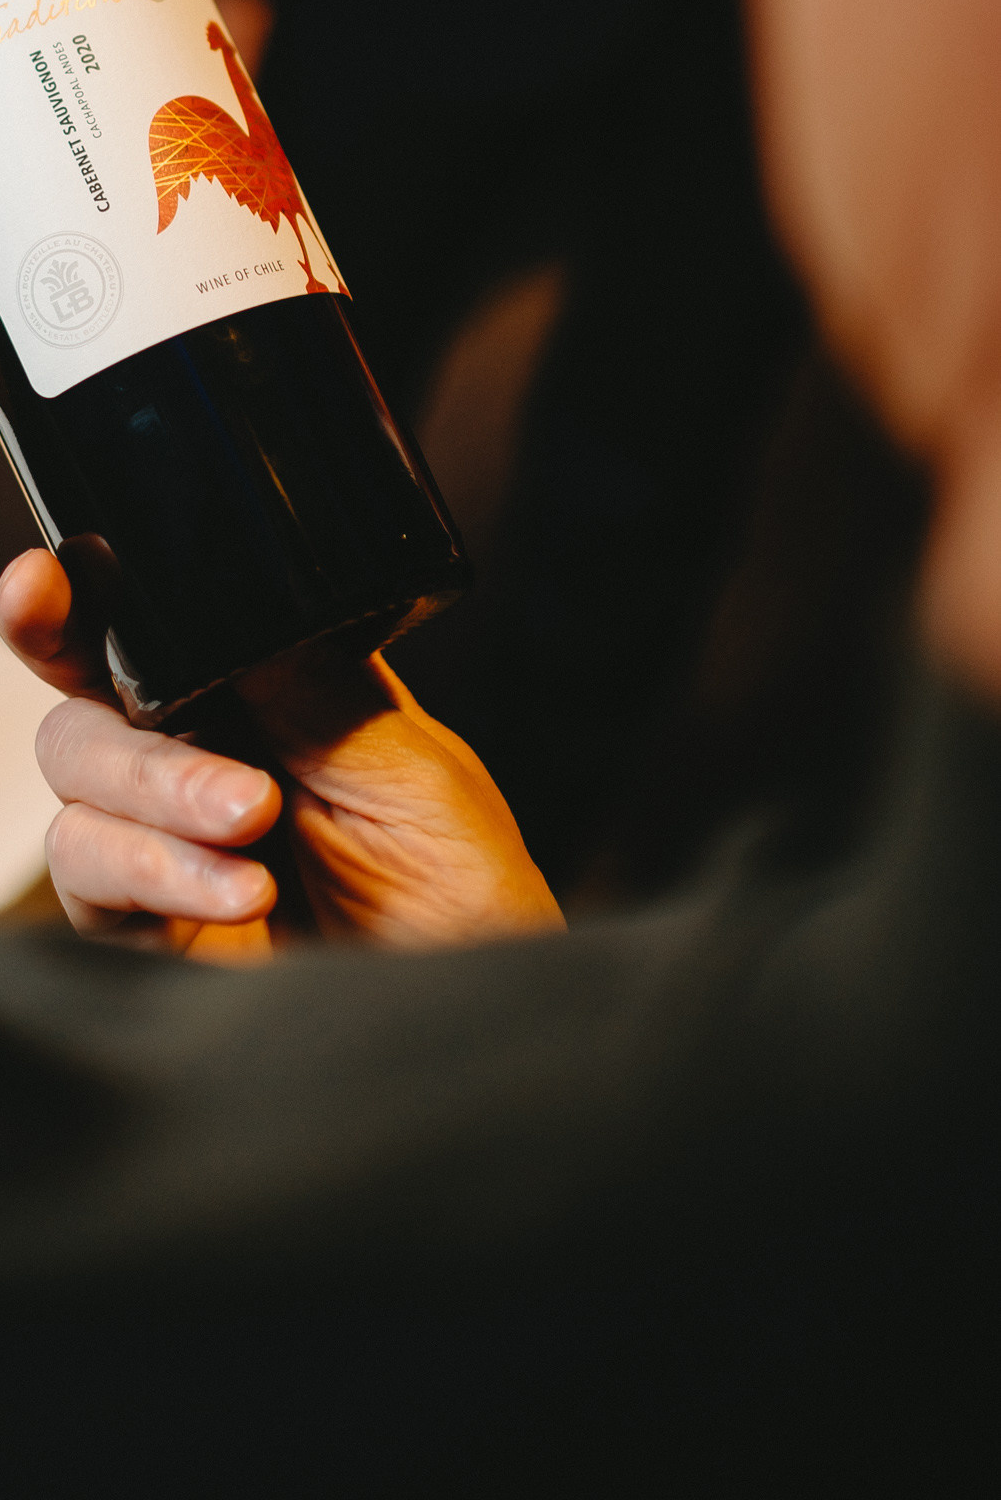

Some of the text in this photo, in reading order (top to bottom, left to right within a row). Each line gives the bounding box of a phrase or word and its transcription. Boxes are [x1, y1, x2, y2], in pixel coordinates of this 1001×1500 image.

[72, 34, 101, 74] 2020
[52, 41, 102, 139] CACHAPOAL ANDES
[29, 50, 110, 213] CABERNET SAUVIGNON
[195, 259, 285, 295] WINE OF CHILE
